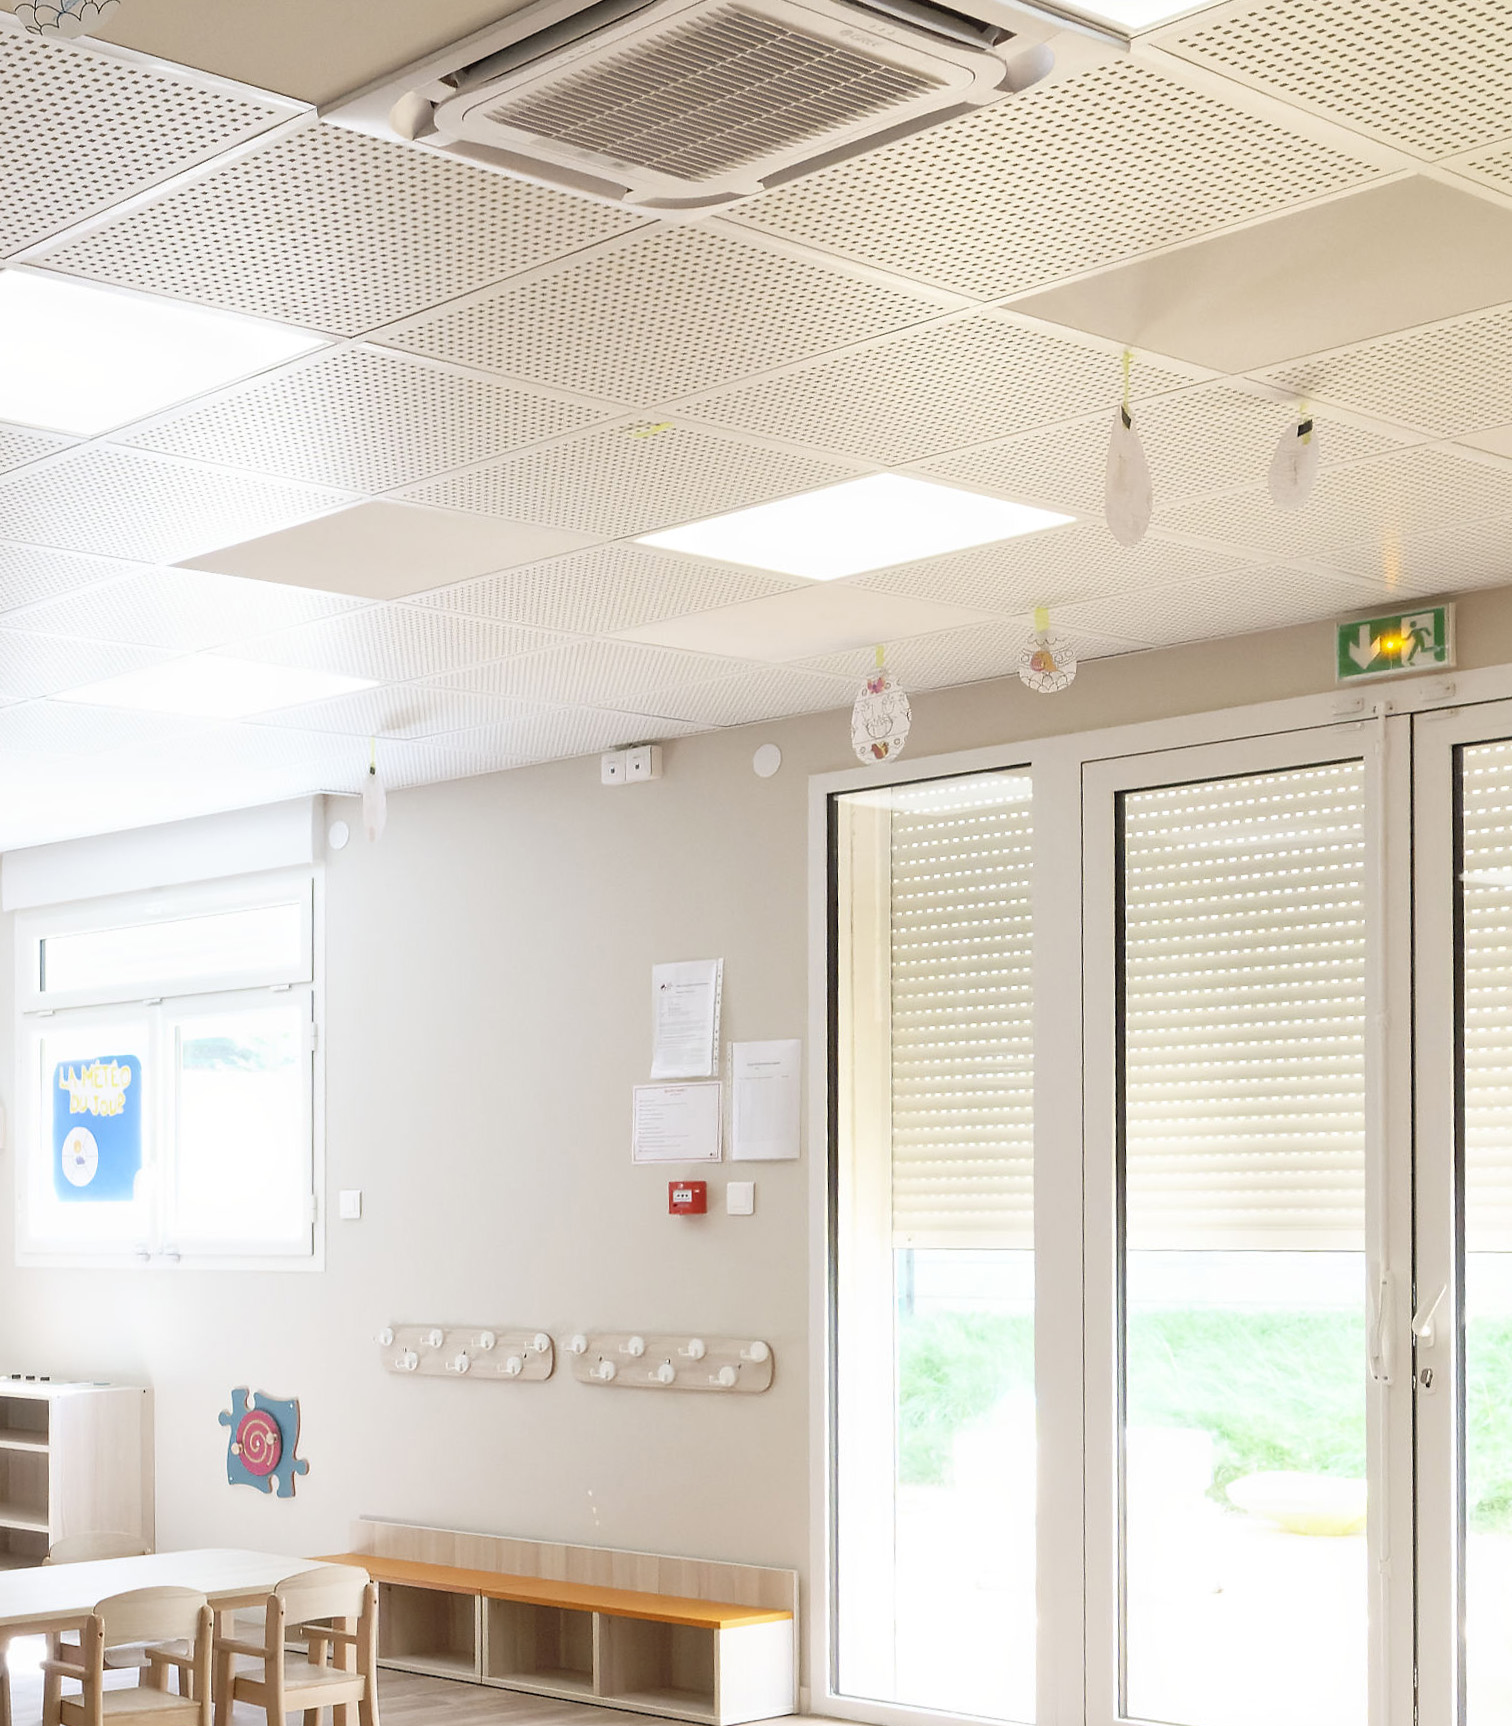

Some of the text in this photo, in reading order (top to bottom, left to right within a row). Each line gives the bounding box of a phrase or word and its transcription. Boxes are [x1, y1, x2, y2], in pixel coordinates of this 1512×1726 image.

[59, 1064, 78, 1089] LA
[70, 1090, 126, 1116] DU JOUR
